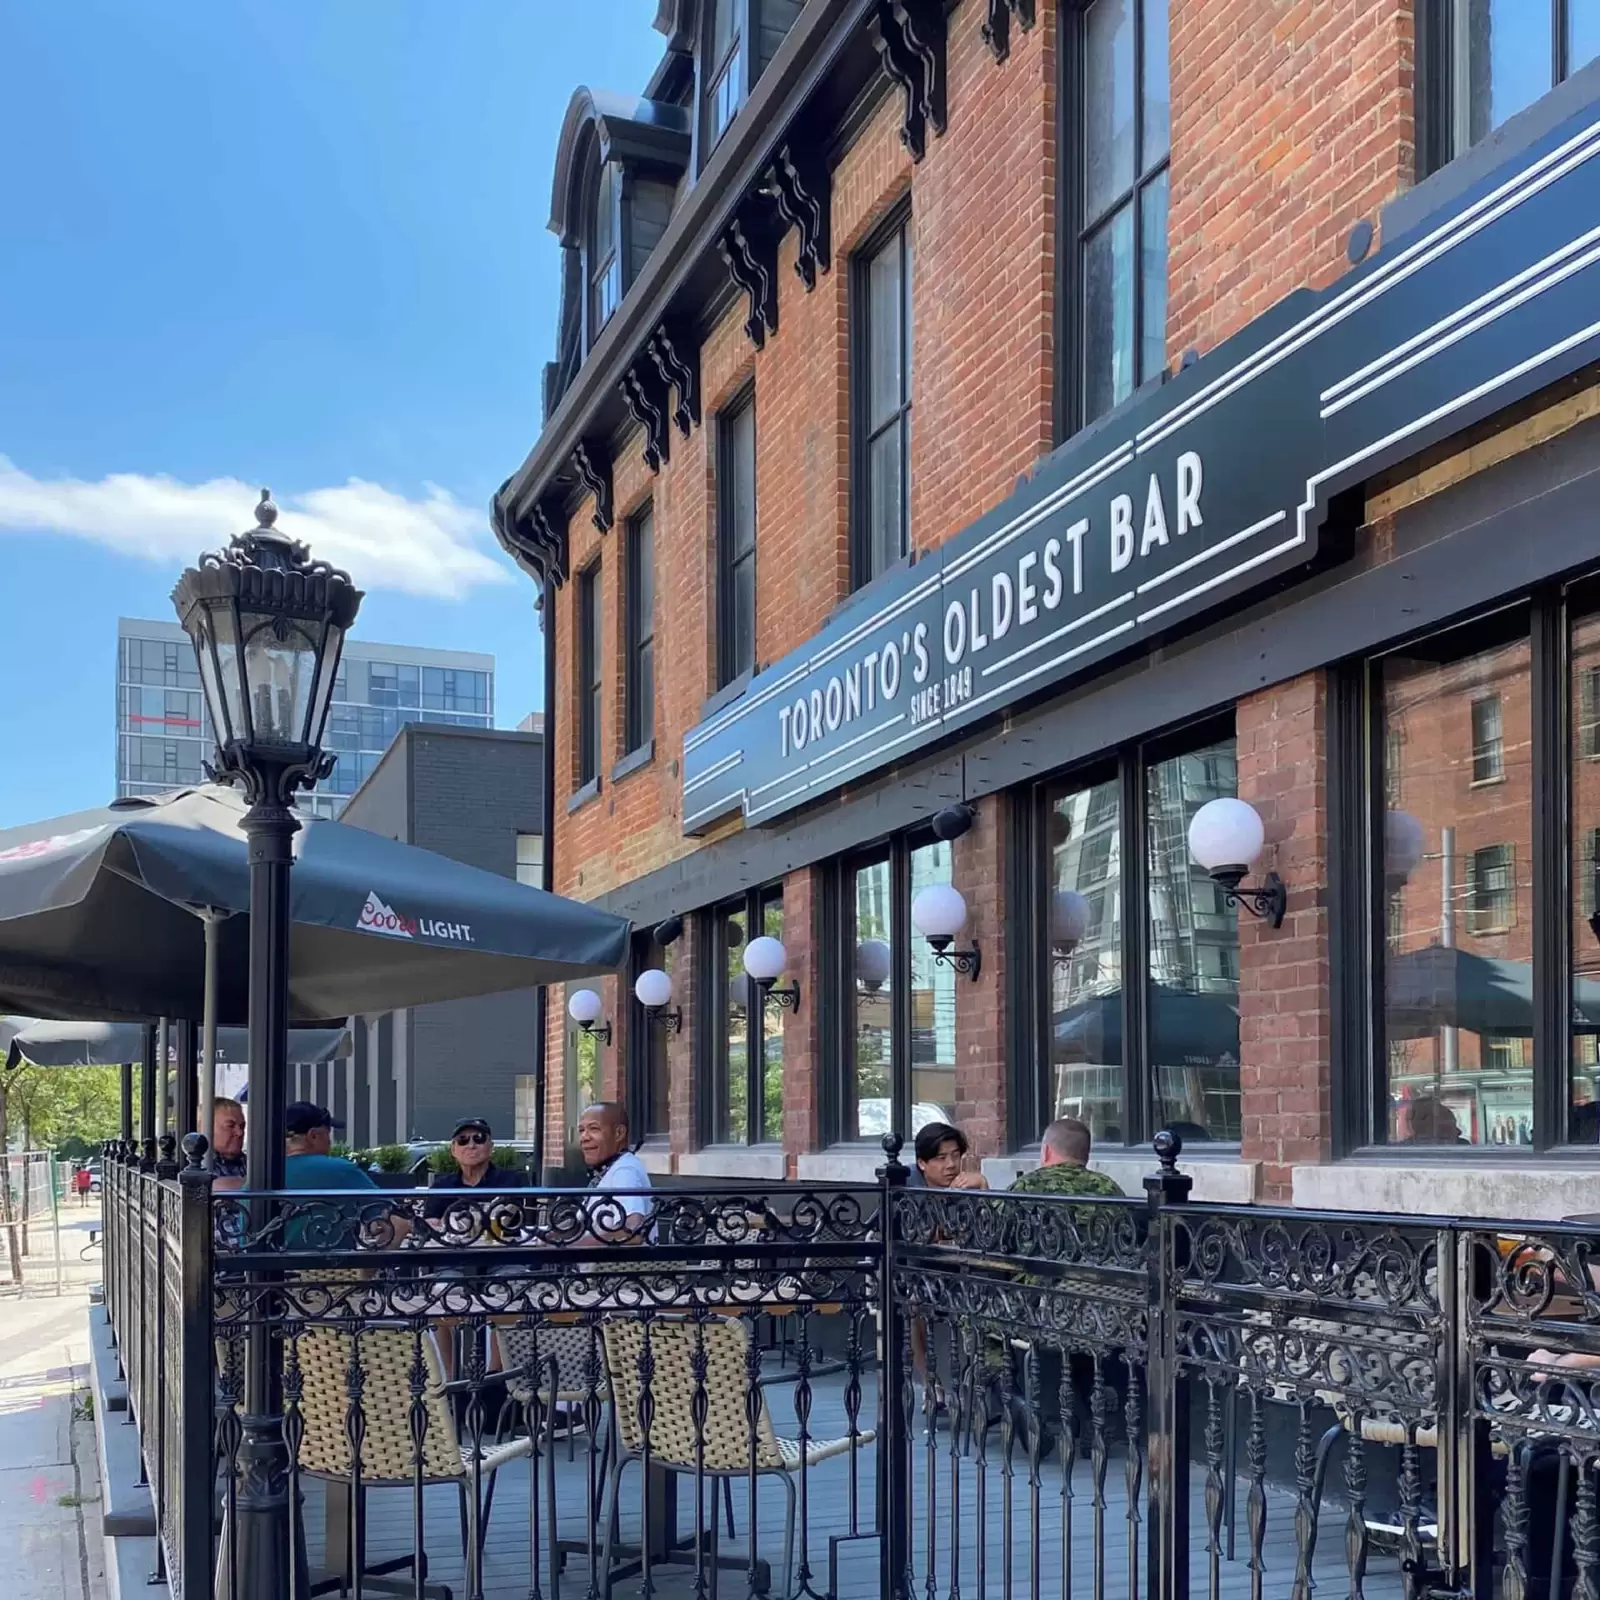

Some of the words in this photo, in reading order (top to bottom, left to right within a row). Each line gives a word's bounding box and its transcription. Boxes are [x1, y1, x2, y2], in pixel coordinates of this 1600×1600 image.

[778, 622, 929, 758] TORONTO'S
[944, 518, 1091, 664] OLDEST
[1110, 451, 1204, 574] BAR
[910, 683, 941, 726] SINCE
[943, 666, 973, 709] 1849
